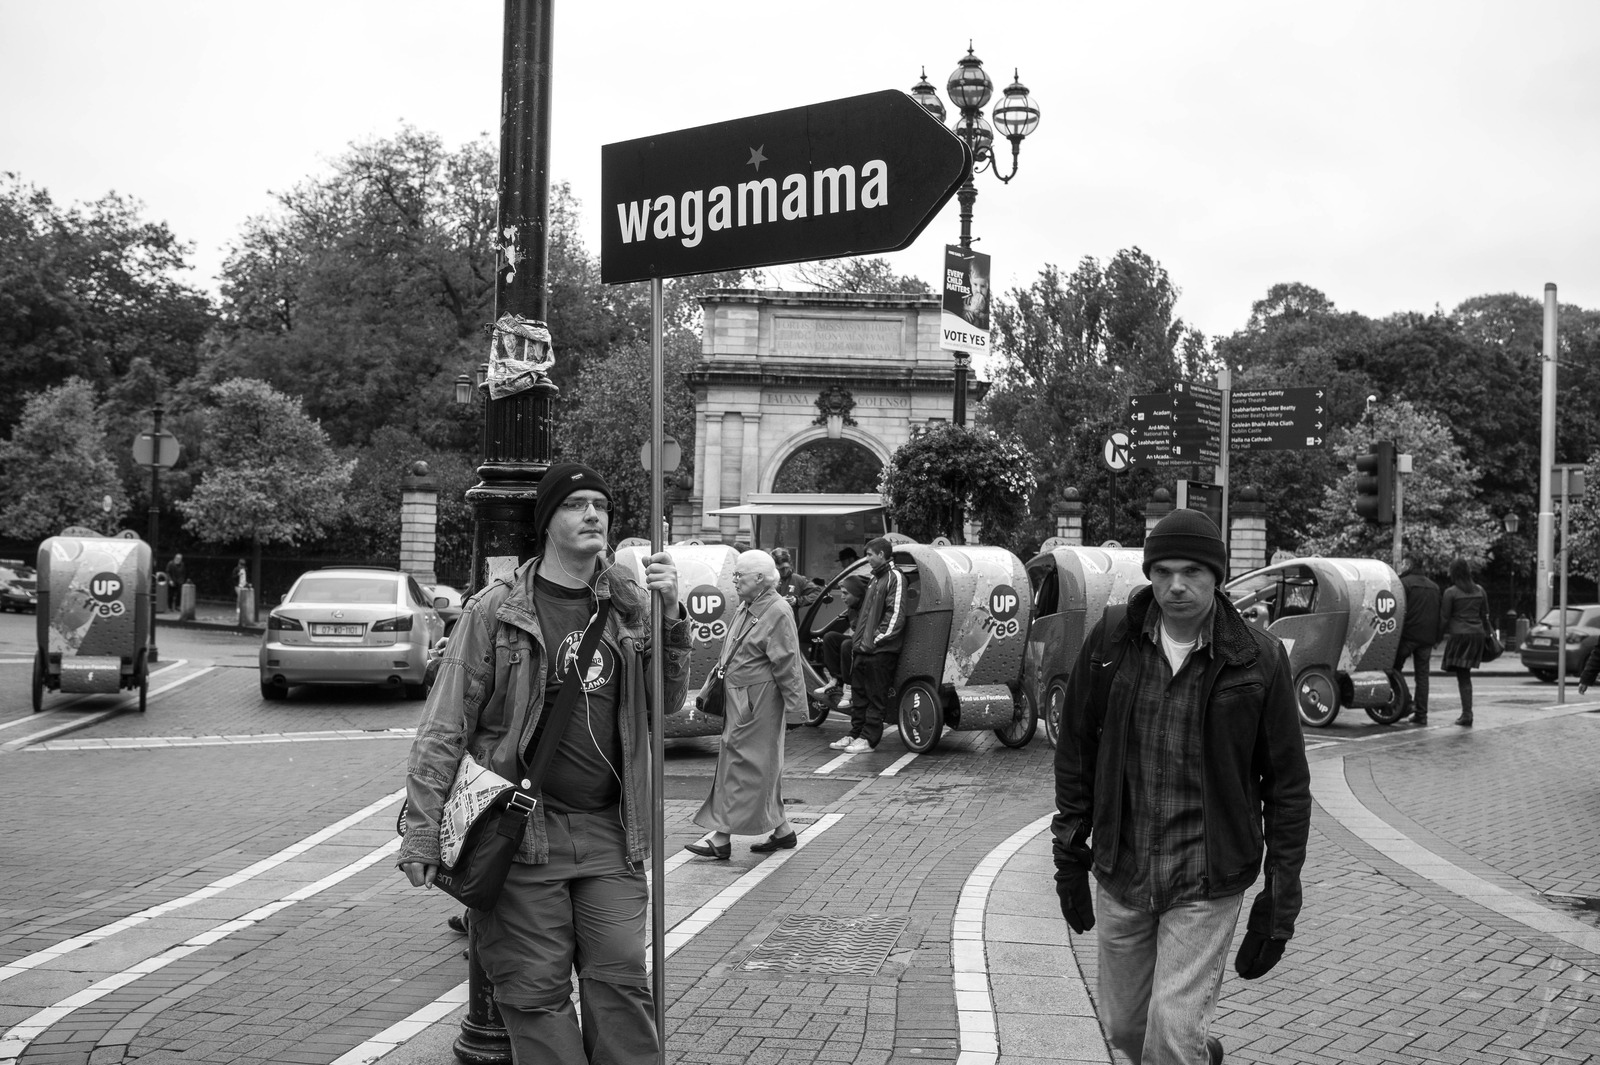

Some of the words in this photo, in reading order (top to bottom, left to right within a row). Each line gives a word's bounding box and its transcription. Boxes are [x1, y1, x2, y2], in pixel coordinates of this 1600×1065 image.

[617, 160, 888, 247] wagamama
[947, 269, 964, 279] EVERY
[947, 276, 963, 285] CHILD
[946, 283, 970, 294] MATTERS
[944, 329, 967, 343] VOTE
[969, 334, 985, 346] YES
[767, 394, 809, 404] TALANA
[858, 397, 907, 407] COLENSO
[93, 580, 120, 595] UP
[83, 598, 124, 616] free
[692, 595, 721, 614] UP
[993, 595, 1016, 613] UP
[1378, 598, 1395, 613] UP
[691, 622, 725, 640] ree
[982, 616, 1017, 637] free
[1370, 616, 1395, 632] free
[914, 693, 921, 708] UP
[689, 710, 694, 720] f
[985, 704, 990, 714] f
[913, 729, 921, 744] UP
